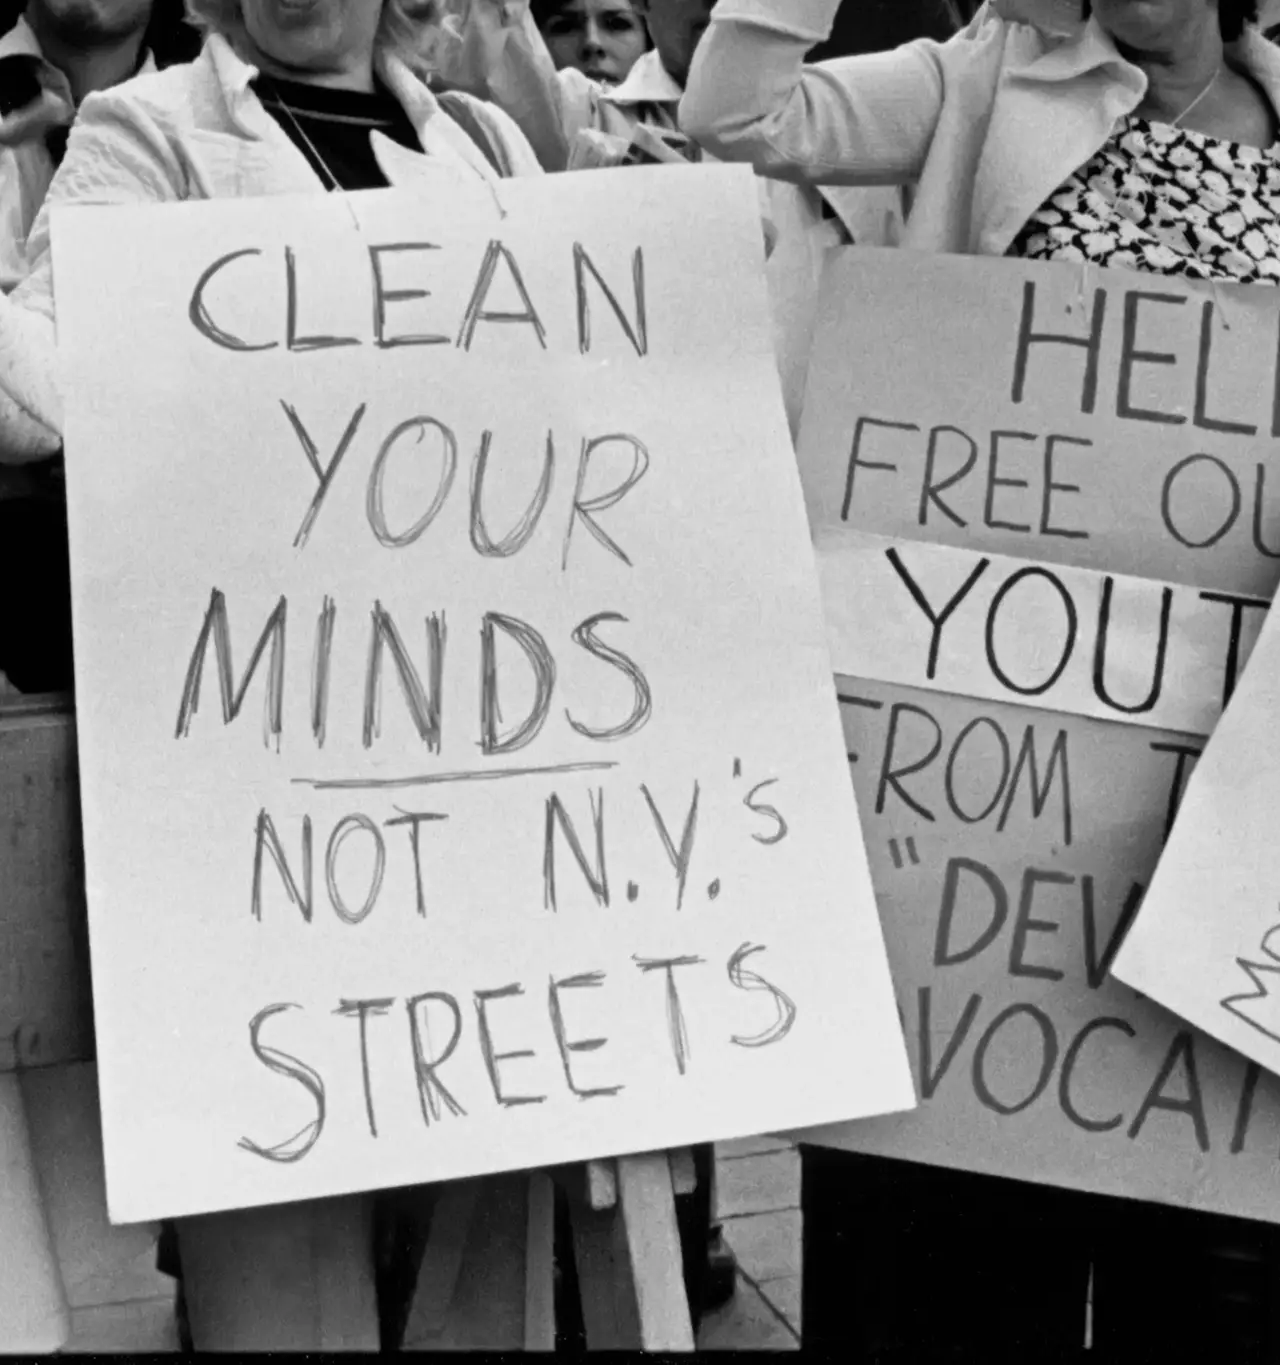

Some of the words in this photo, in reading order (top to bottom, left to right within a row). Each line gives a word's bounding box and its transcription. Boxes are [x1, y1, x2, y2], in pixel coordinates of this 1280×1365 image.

[188, 239, 648, 357] CLEAN
[278, 398, 650, 570] YOUR
[841, 416, 1093, 539] FREE
[175, 587, 652, 755] MINDS
[250, 805, 448, 923] NOT
[236, 941, 797, 1164] STREETS
